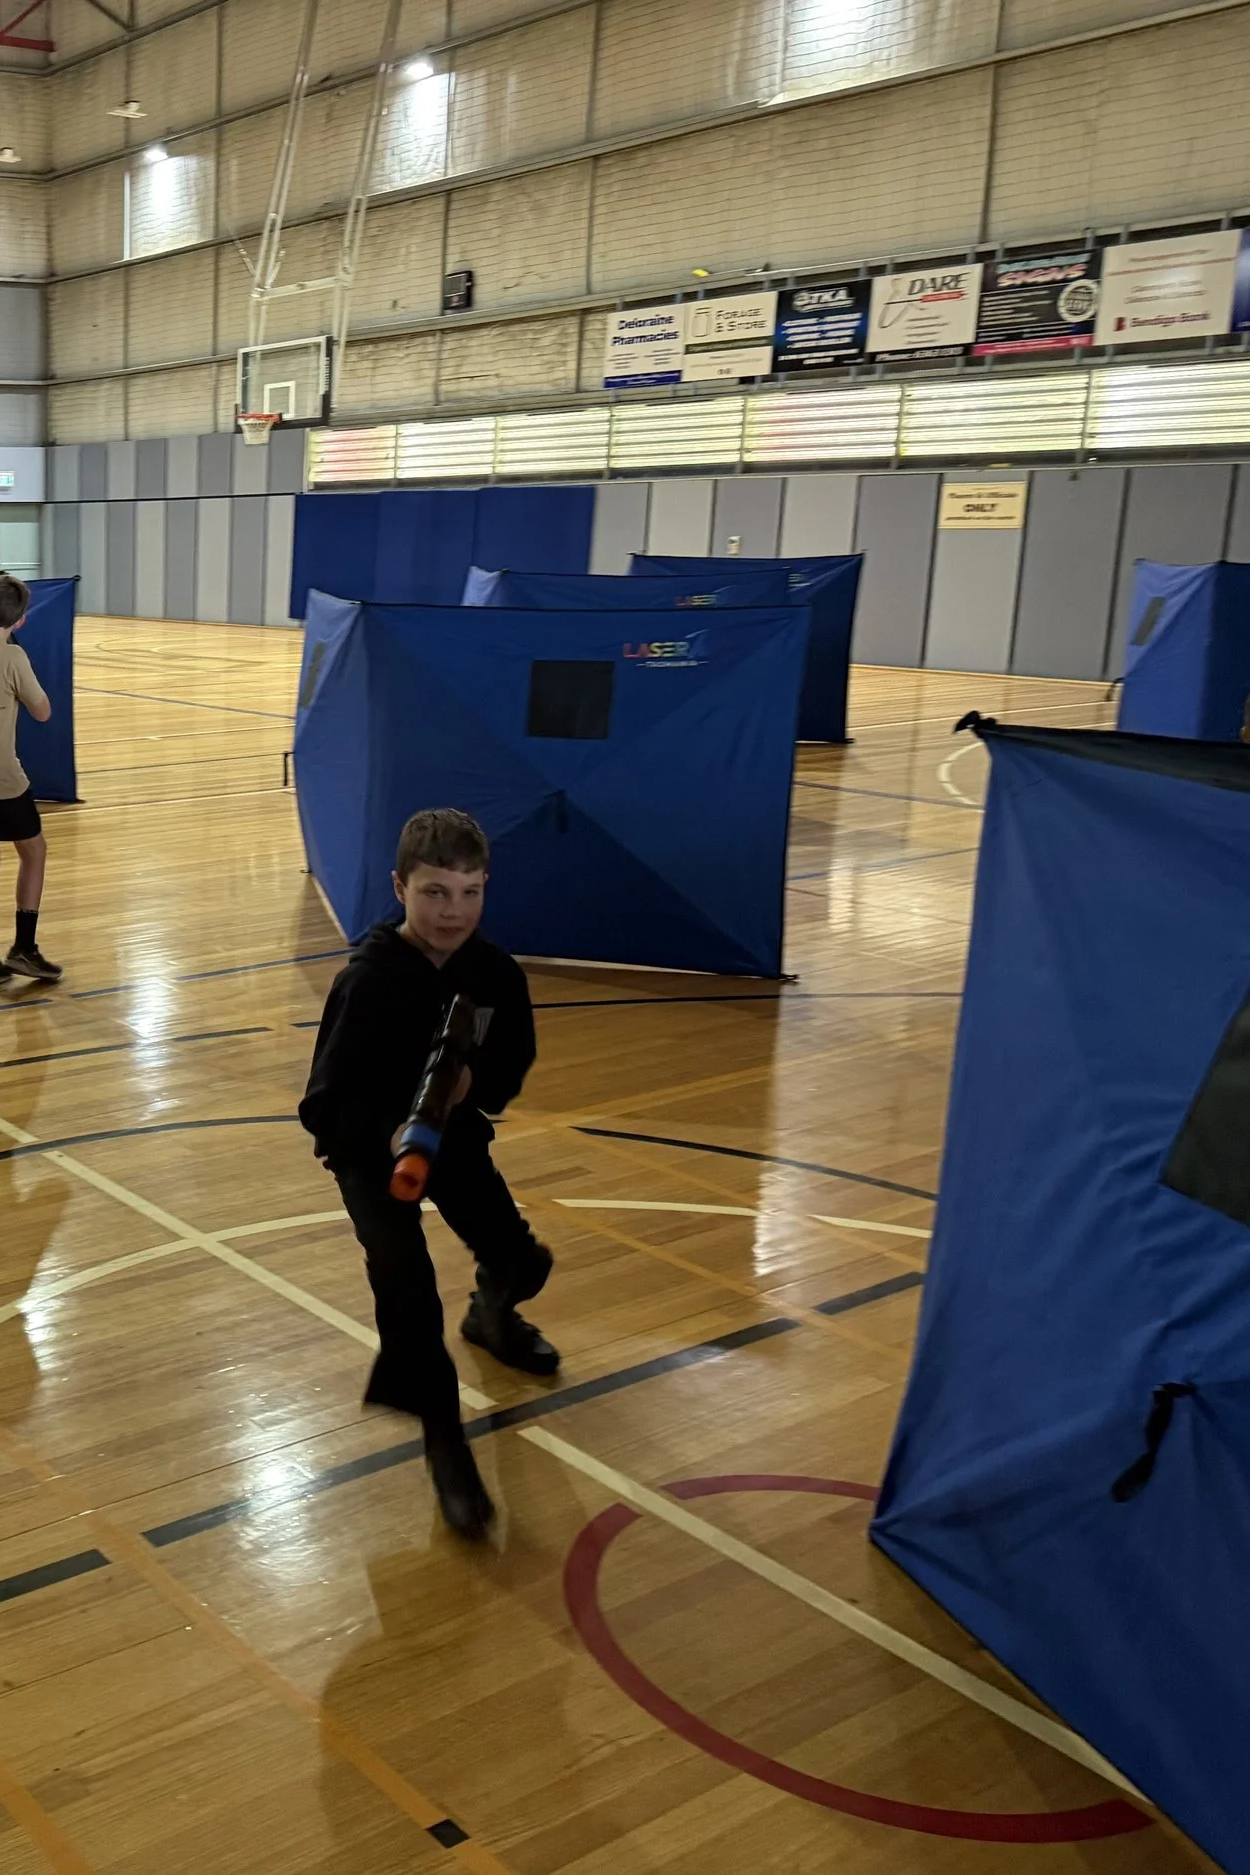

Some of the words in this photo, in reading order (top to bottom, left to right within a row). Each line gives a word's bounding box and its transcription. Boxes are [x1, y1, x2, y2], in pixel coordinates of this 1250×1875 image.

[908, 272, 970, 295] DARE
[611, 328, 679, 346] Pharmacies
[623, 642, 689, 658] LASER
